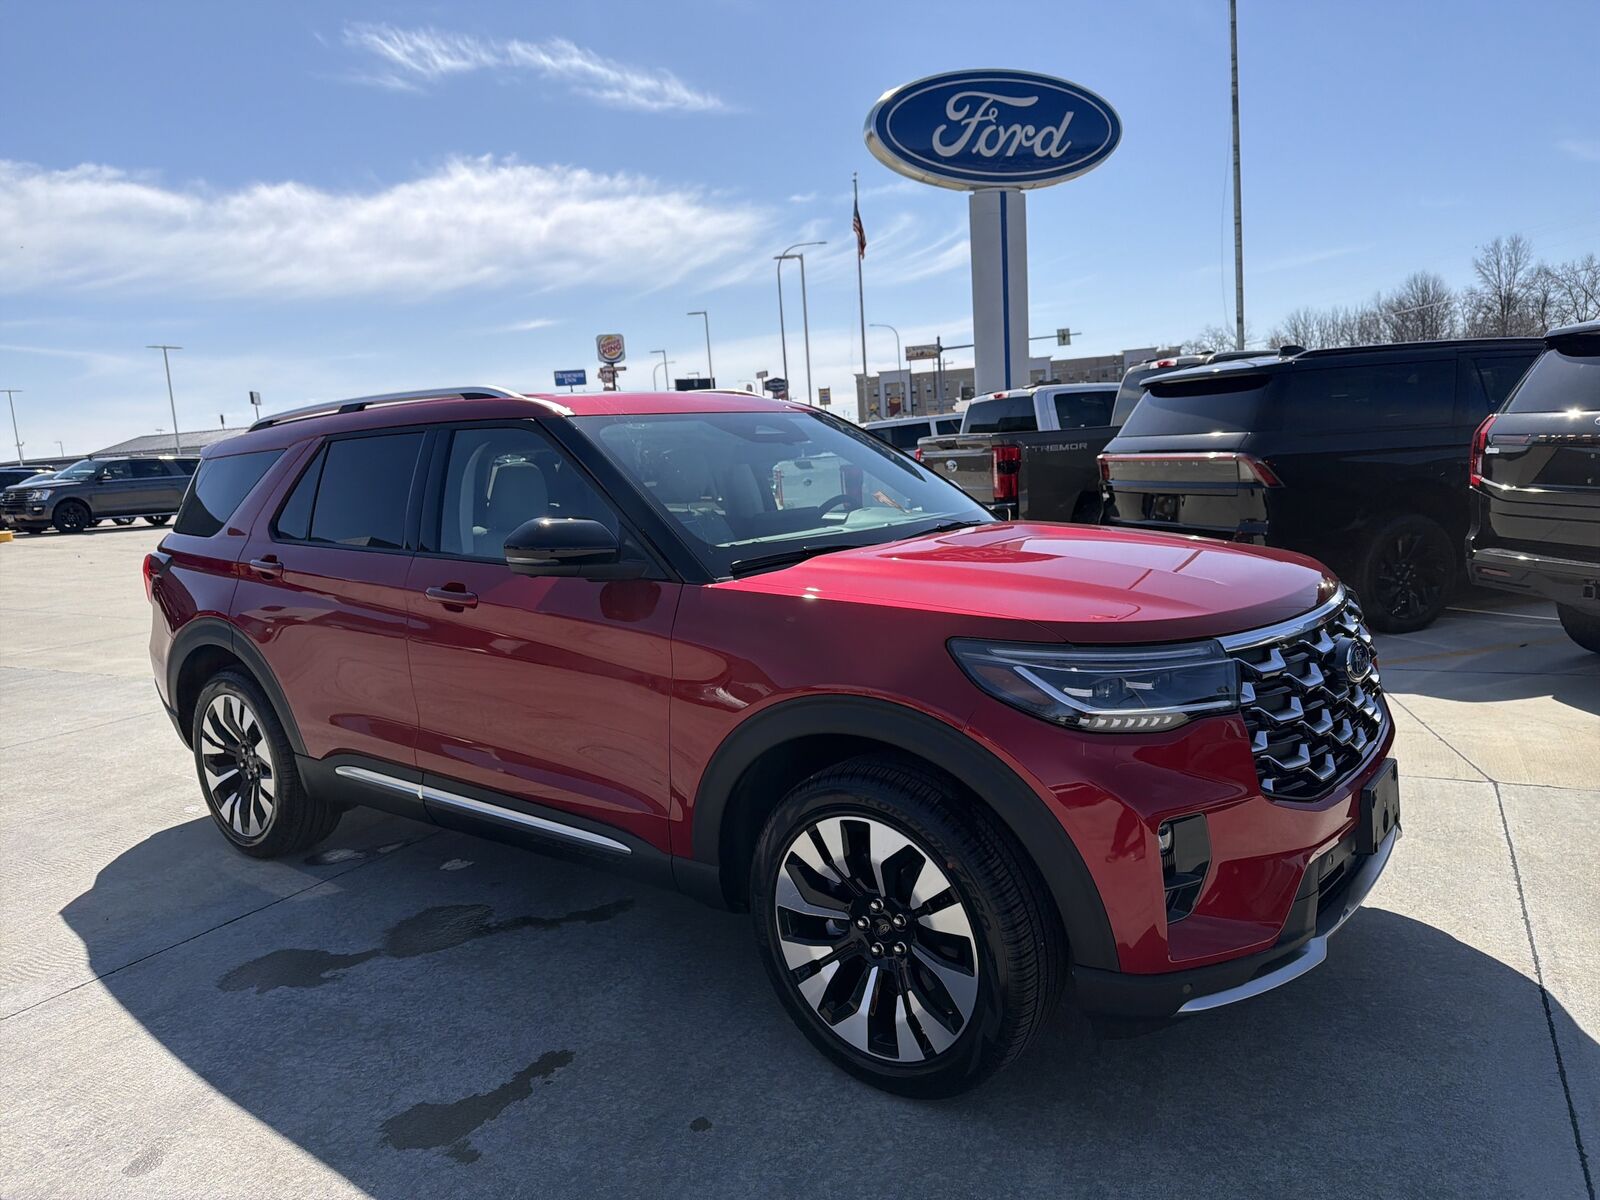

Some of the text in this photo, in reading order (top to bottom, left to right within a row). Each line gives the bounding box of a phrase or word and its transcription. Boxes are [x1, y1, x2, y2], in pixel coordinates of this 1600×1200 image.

[932, 91, 1074, 158] Ford
[603, 343, 622, 354] KING
[1031, 442, 1088, 452] TREMOR
